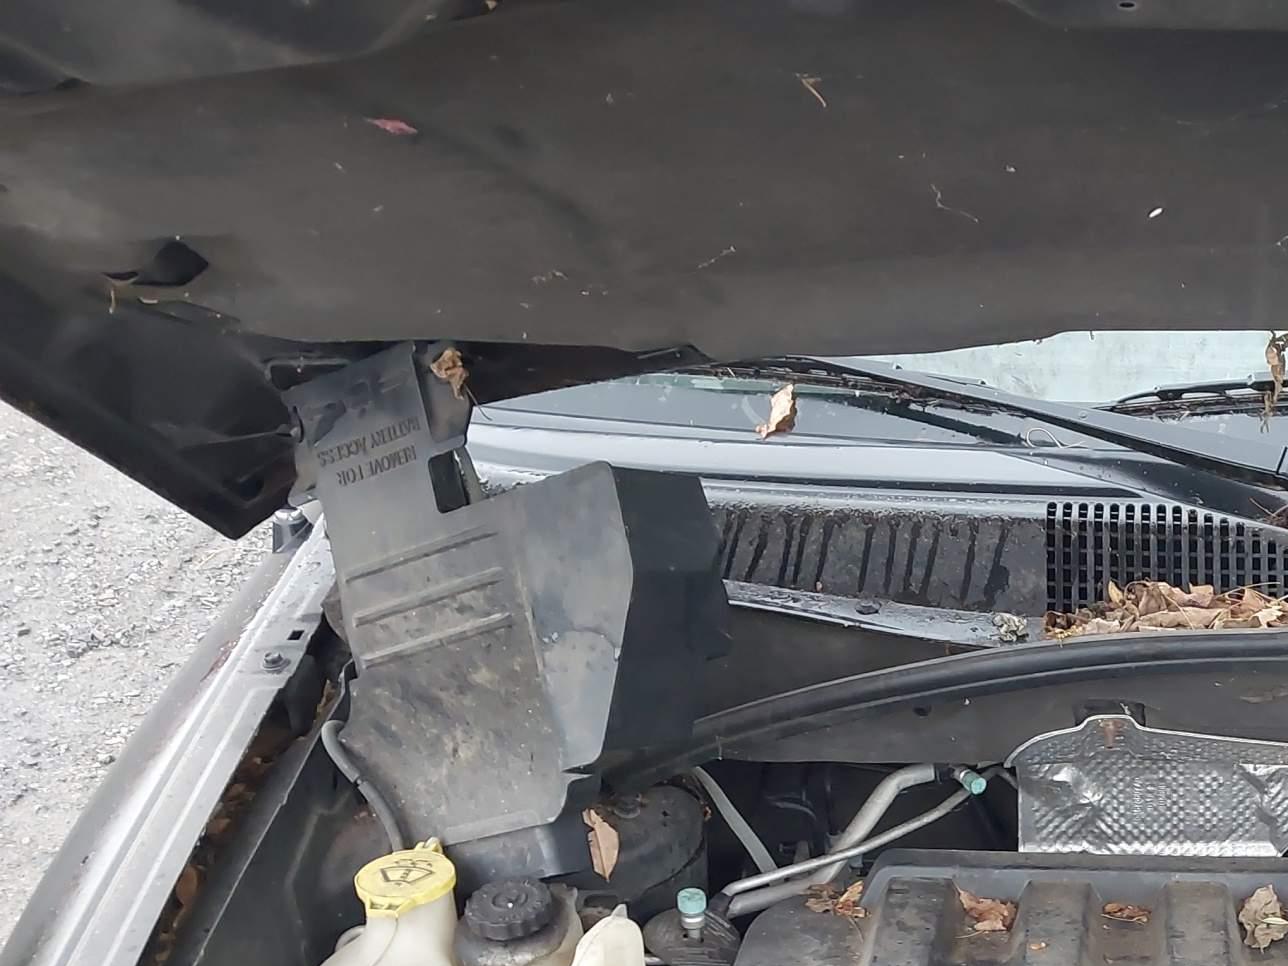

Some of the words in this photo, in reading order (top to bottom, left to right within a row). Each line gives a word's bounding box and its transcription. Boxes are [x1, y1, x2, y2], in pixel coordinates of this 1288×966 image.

[370, 417, 420, 448] BATTERY
[317, 437, 367, 467] ACCESS
[369, 445, 416, 475] REMOVE
[336, 465, 364, 486] FOR
